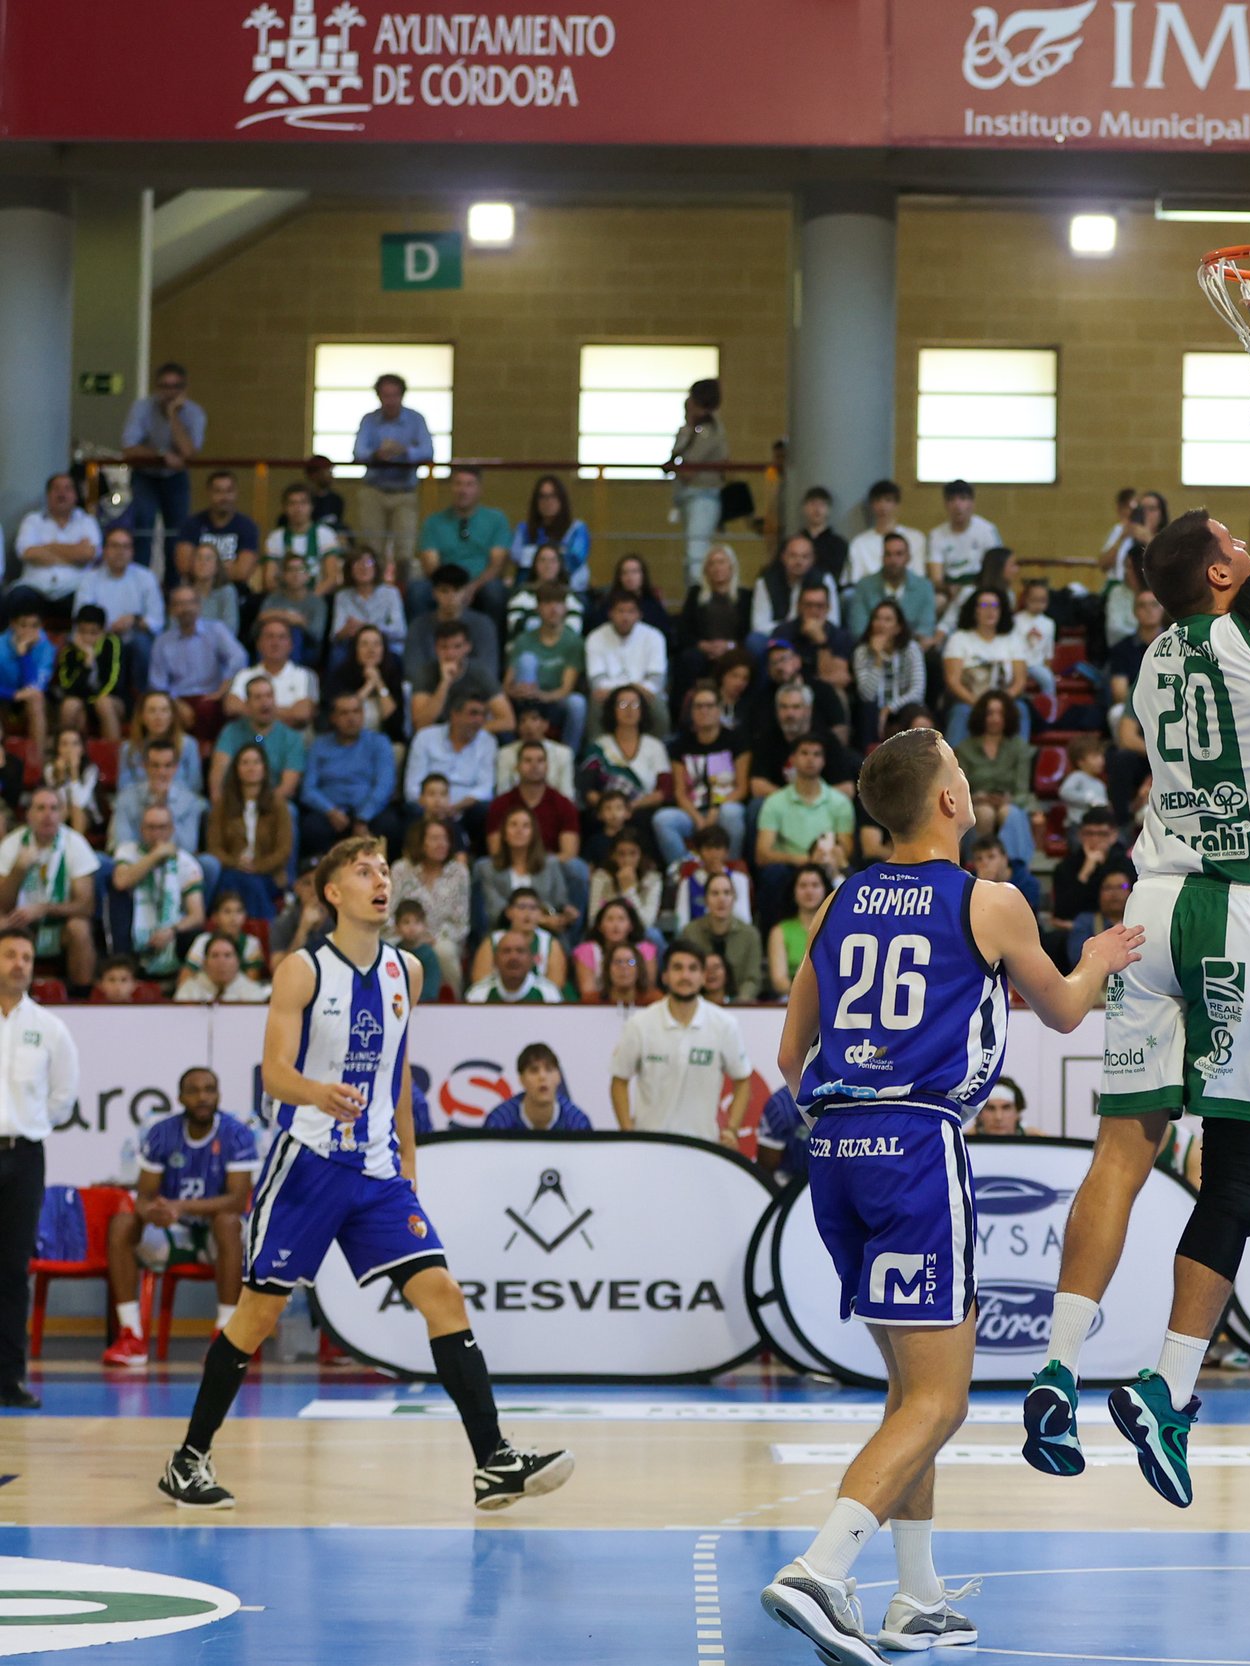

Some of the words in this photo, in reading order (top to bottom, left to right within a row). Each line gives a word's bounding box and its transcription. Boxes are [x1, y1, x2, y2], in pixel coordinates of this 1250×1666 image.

[373, 14, 616, 57] AYUNTAMIENTO
[373, 64, 414, 106] DE
[420, 58, 579, 107] CÓRDOBA
[964, 109, 1092, 139] Instituto
[405, 243, 440, 282] D
[1157, 672, 1223, 762] 20
[853, 886, 933, 915] SAMAR
[834, 933, 932, 1030] 26
[1209, 1002, 1242, 1015] REALE
[837, 1137, 904, 1157] RURAL
[378, 1280, 726, 1312] ARESVEGA
[925, 1253, 937, 1305] MEDA
